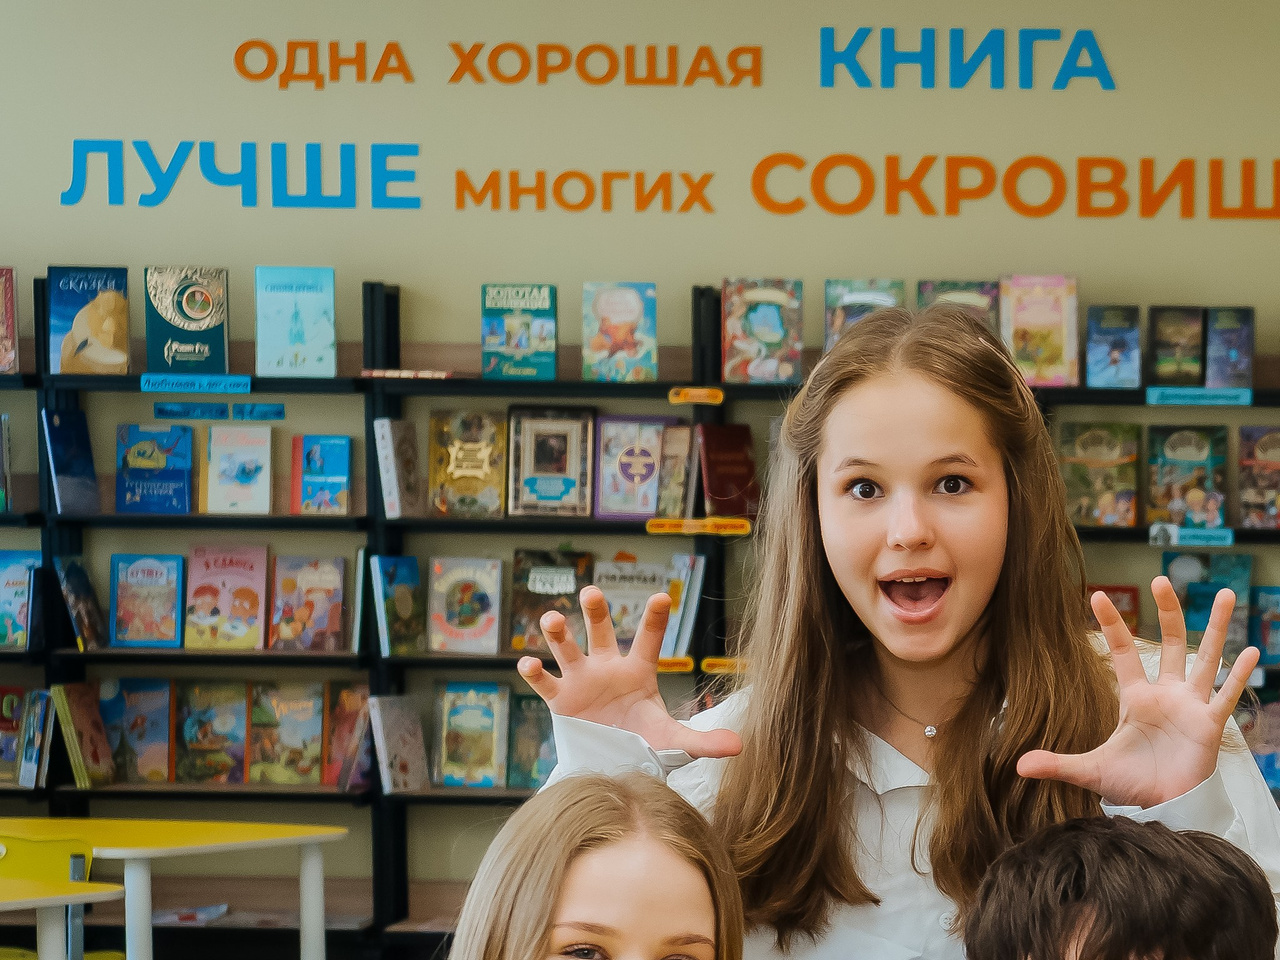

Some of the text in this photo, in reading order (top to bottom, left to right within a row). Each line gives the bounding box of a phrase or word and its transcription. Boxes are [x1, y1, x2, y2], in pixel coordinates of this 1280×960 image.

[234, 28, 1116, 91] ОДНА ХОРОШАЯ КНИГА
[61, 140, 421, 209] ЛУЧШЕ
[455, 171, 714, 213] МНОГИХ
